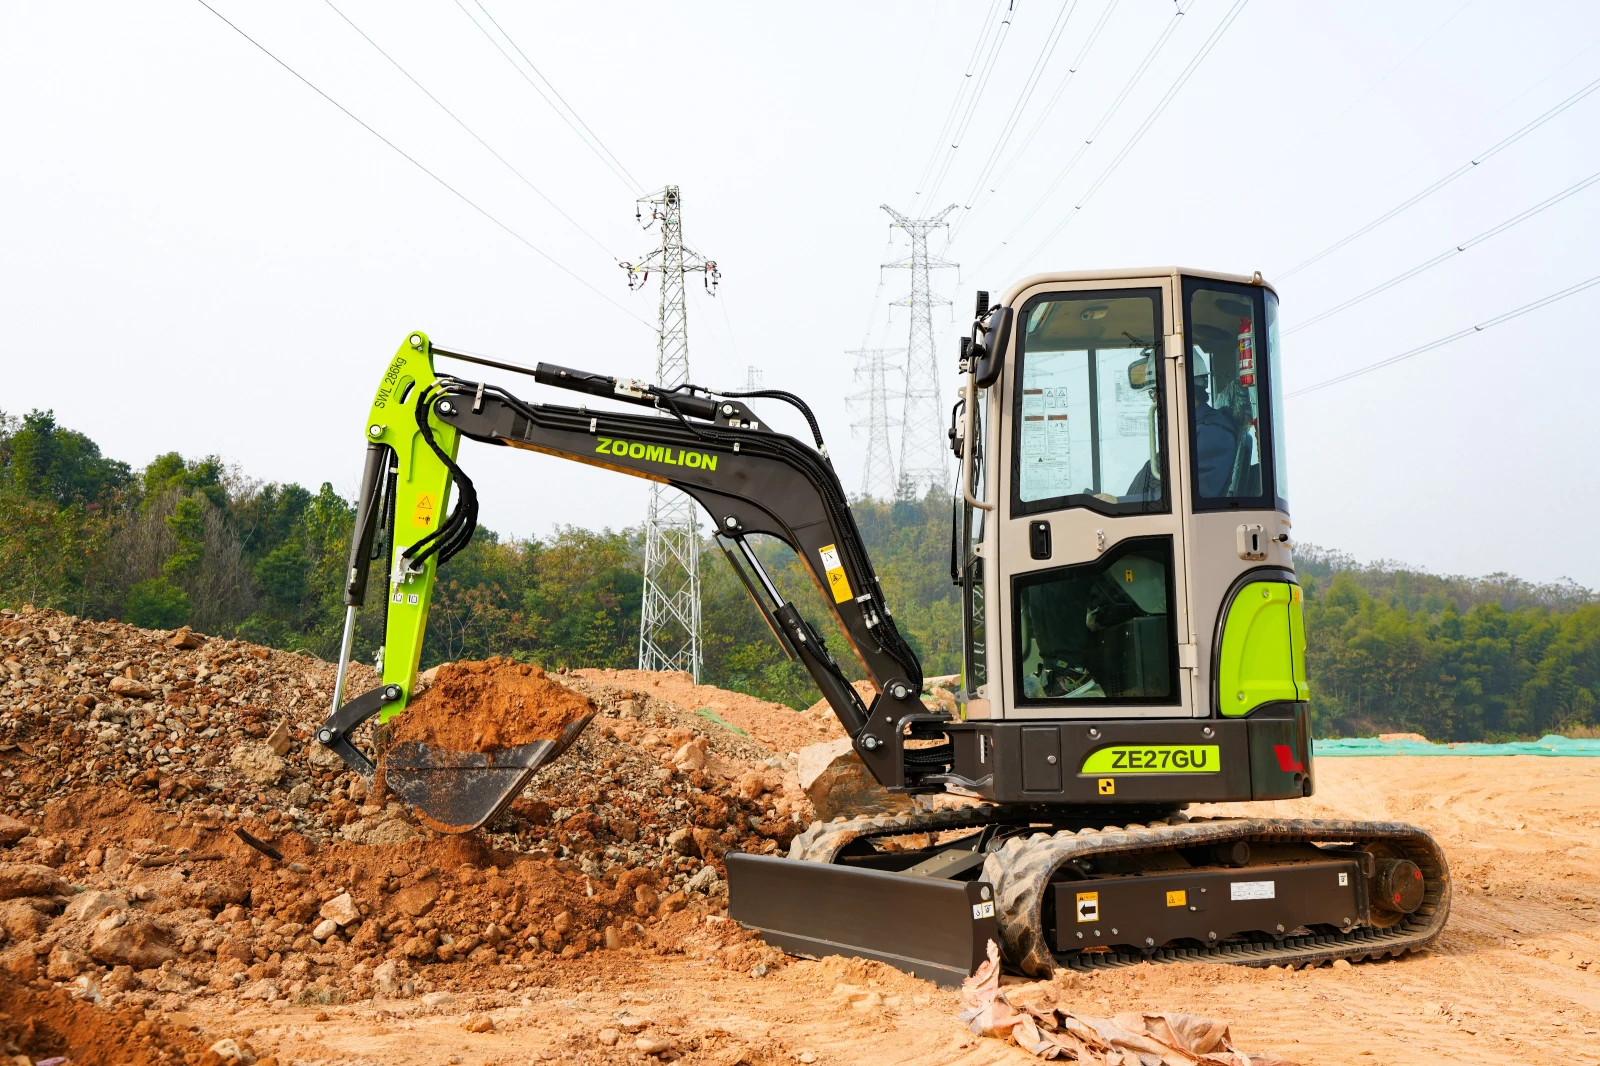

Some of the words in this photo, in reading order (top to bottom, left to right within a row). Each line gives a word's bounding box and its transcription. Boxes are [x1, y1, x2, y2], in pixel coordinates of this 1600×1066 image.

[374, 388, 392, 409] SWL
[384, 357, 407, 385] 286kg
[595, 437, 718, 471] ZOOMLION
[1111, 750, 1207, 769] ZE27GU
